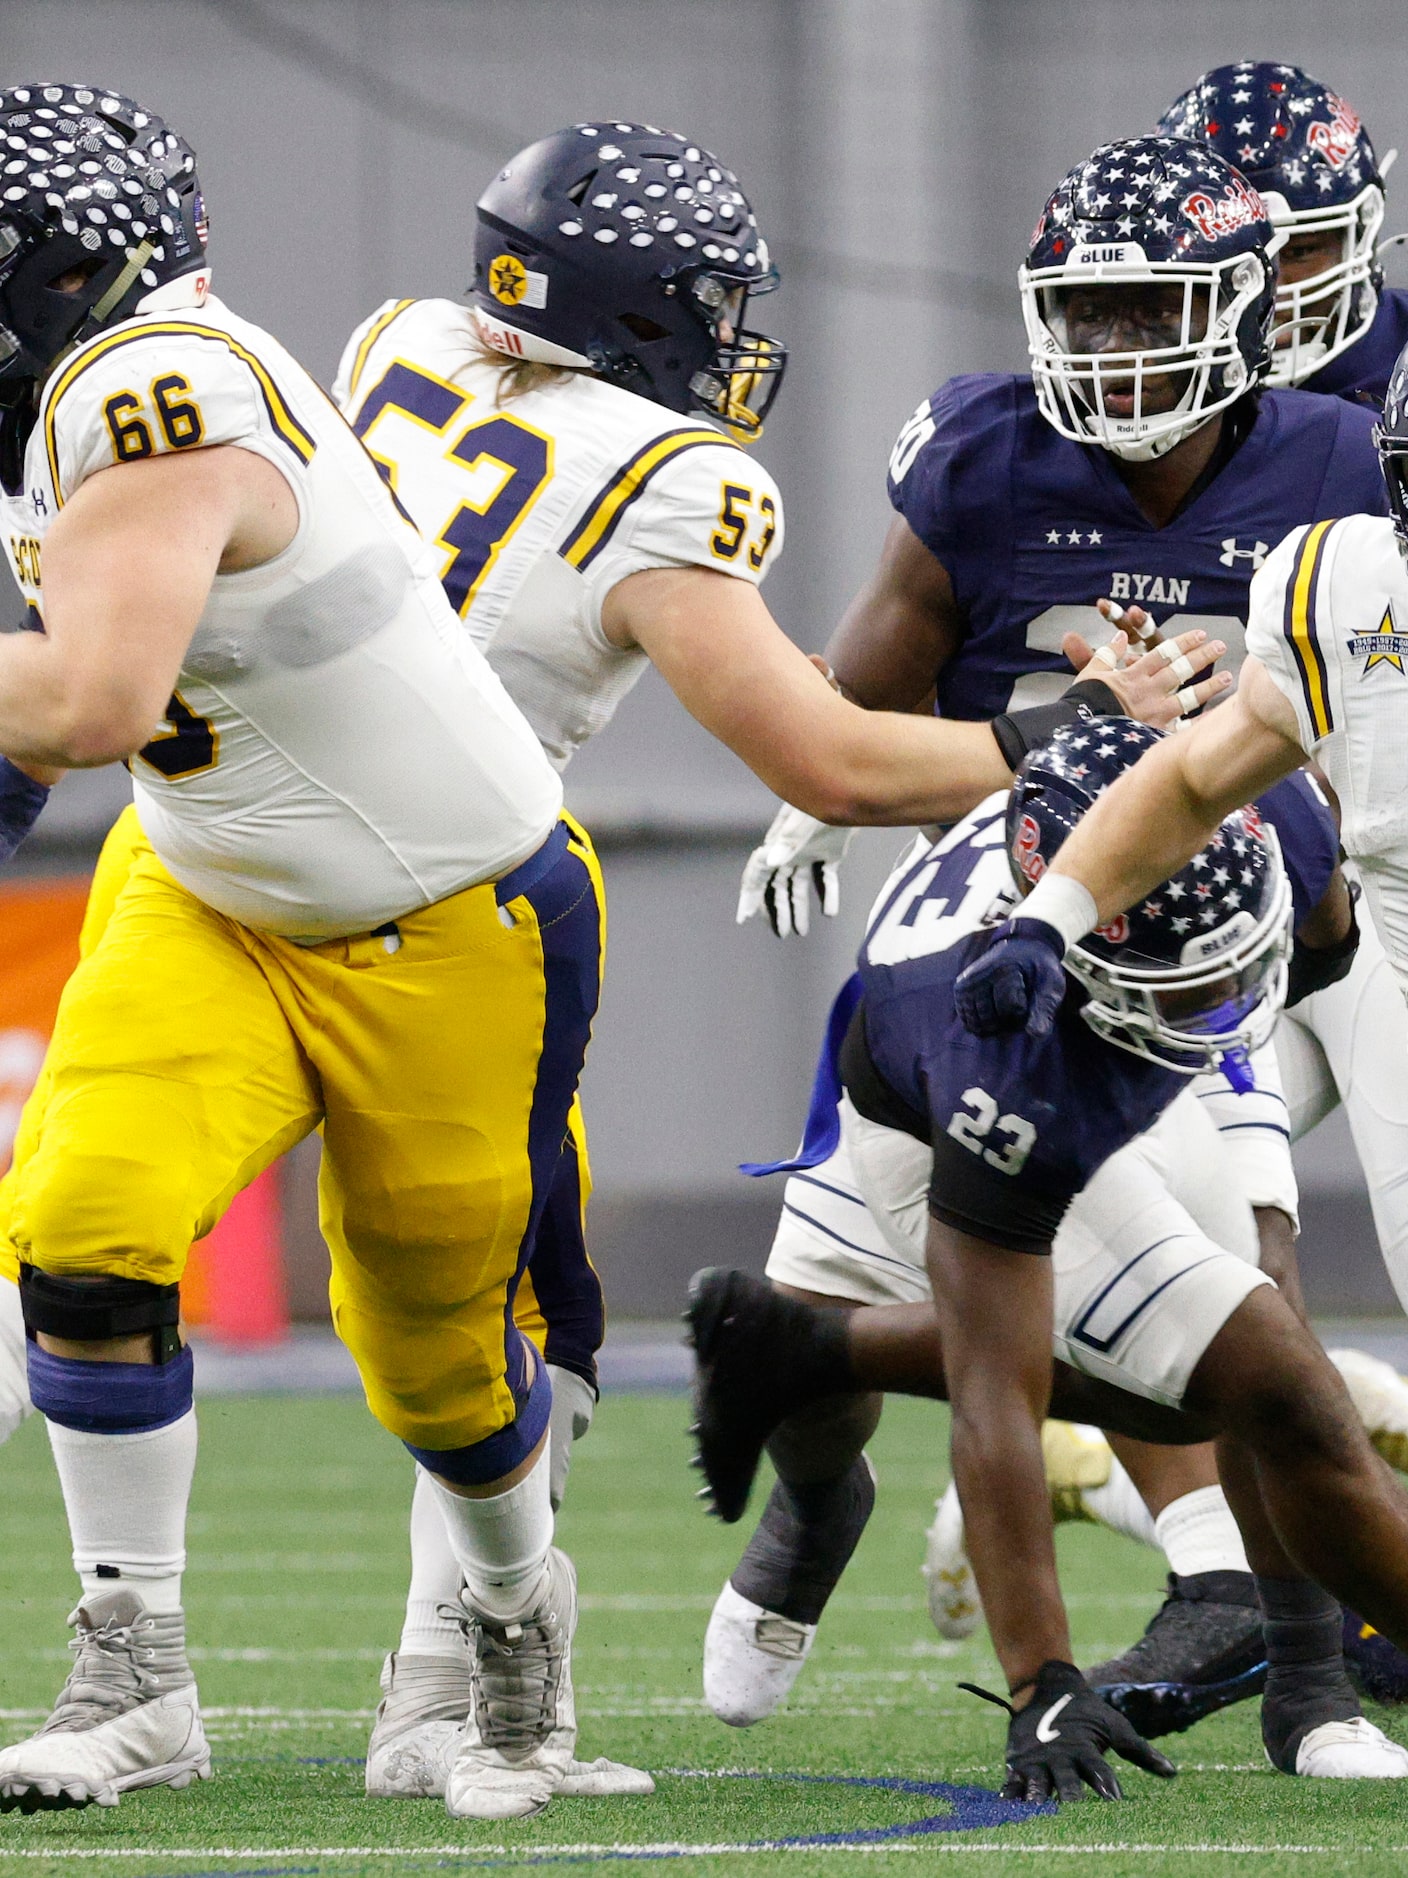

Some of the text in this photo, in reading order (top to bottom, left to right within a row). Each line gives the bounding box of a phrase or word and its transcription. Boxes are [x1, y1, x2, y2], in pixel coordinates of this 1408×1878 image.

[7, 113, 32, 128] PRIDE
[55, 119, 80, 135] PRIDE
[80, 135, 103, 153] PRIDE
[1080, 248, 1125, 263] BLUE
[101, 370, 206, 462] 66
[708, 479, 775, 573] 53
[1110, 572, 1191, 605] RYAN
[946, 1086, 1038, 1176] 23
